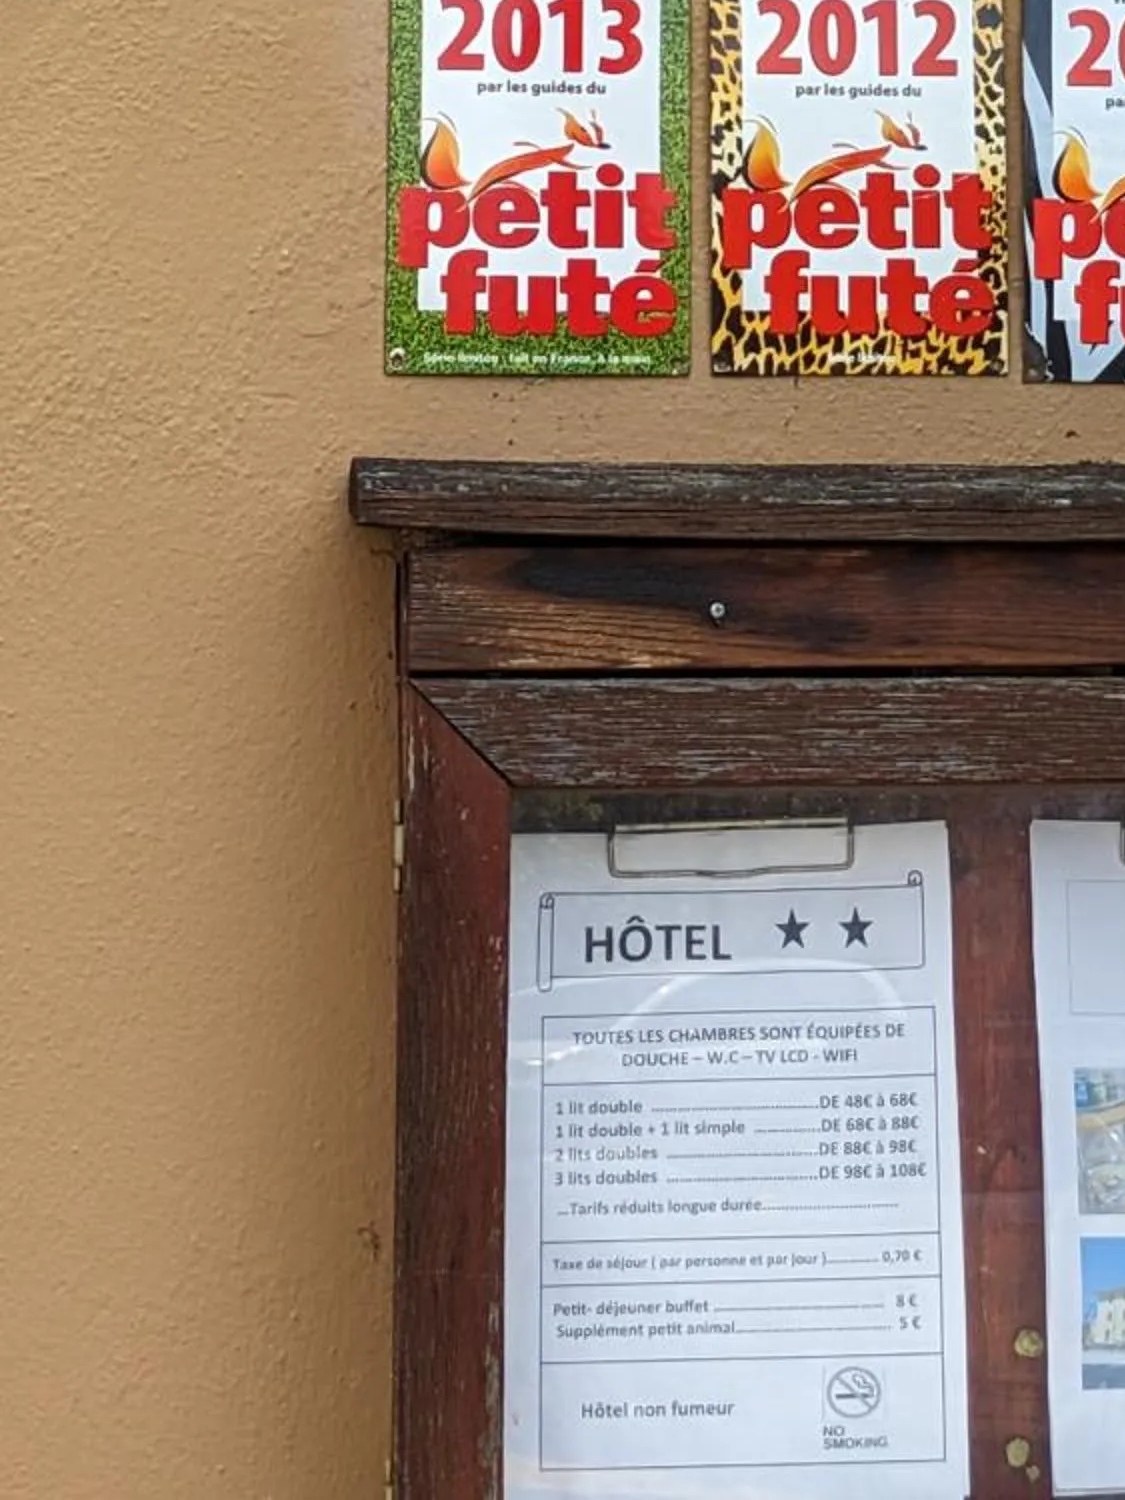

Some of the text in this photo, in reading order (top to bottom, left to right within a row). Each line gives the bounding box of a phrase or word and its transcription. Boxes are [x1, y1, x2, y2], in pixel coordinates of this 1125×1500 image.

[477, 80, 606, 96] par les guides du
[796, 84, 921, 99] par les guides du
[395, 163, 676, 268] petit
[722, 164, 992, 268] petit
[440, 250, 677, 337] futé
[765, 250, 992, 336] futé
[584, 915, 732, 963] HÔTEL
[573, 1022, 904, 1045] TOUTES LES CHAMBRES SONT ÉQUIPÉES DE
[622, 1051, 688, 1067] DOUCHE
[756, 1051, 776, 1065] TV
[780, 1049, 808, 1063] LCD
[823, 1049, 857, 1062] WIFI
[556, 1092, 918, 1115] 1 lit double DE 48€ à 68€
[556, 1116, 919, 1138] 1 lit double 1 lit simple DE 68€ à 88€
[554, 1140, 916, 1161] 2 lits doubles DE 88€ à 98€
[554, 1162, 927, 1186] 3 lits doubles DE 98€ à 108€
[613, 1200, 663, 1213] réduits
[668, 1199, 717, 1215] longue
[721, 1197, 761, 1212] durée
[587, 1258, 602, 1269] de
[607, 1255, 648, 1270] séjour
[685, 1255, 747, 1270] personne
[750, 1255, 763, 1265] et
[767, 1256, 788, 1268] par
[596, 1301, 661, 1316] déjeuner
[665, 1300, 709, 1313] buffet
[557, 1321, 735, 1340] Supplément petit animal
[581, 1401, 734, 1418] Hôtel non fumeur
[823, 1426, 845, 1437] NO
[823, 1436, 887, 1449] SMOKING
